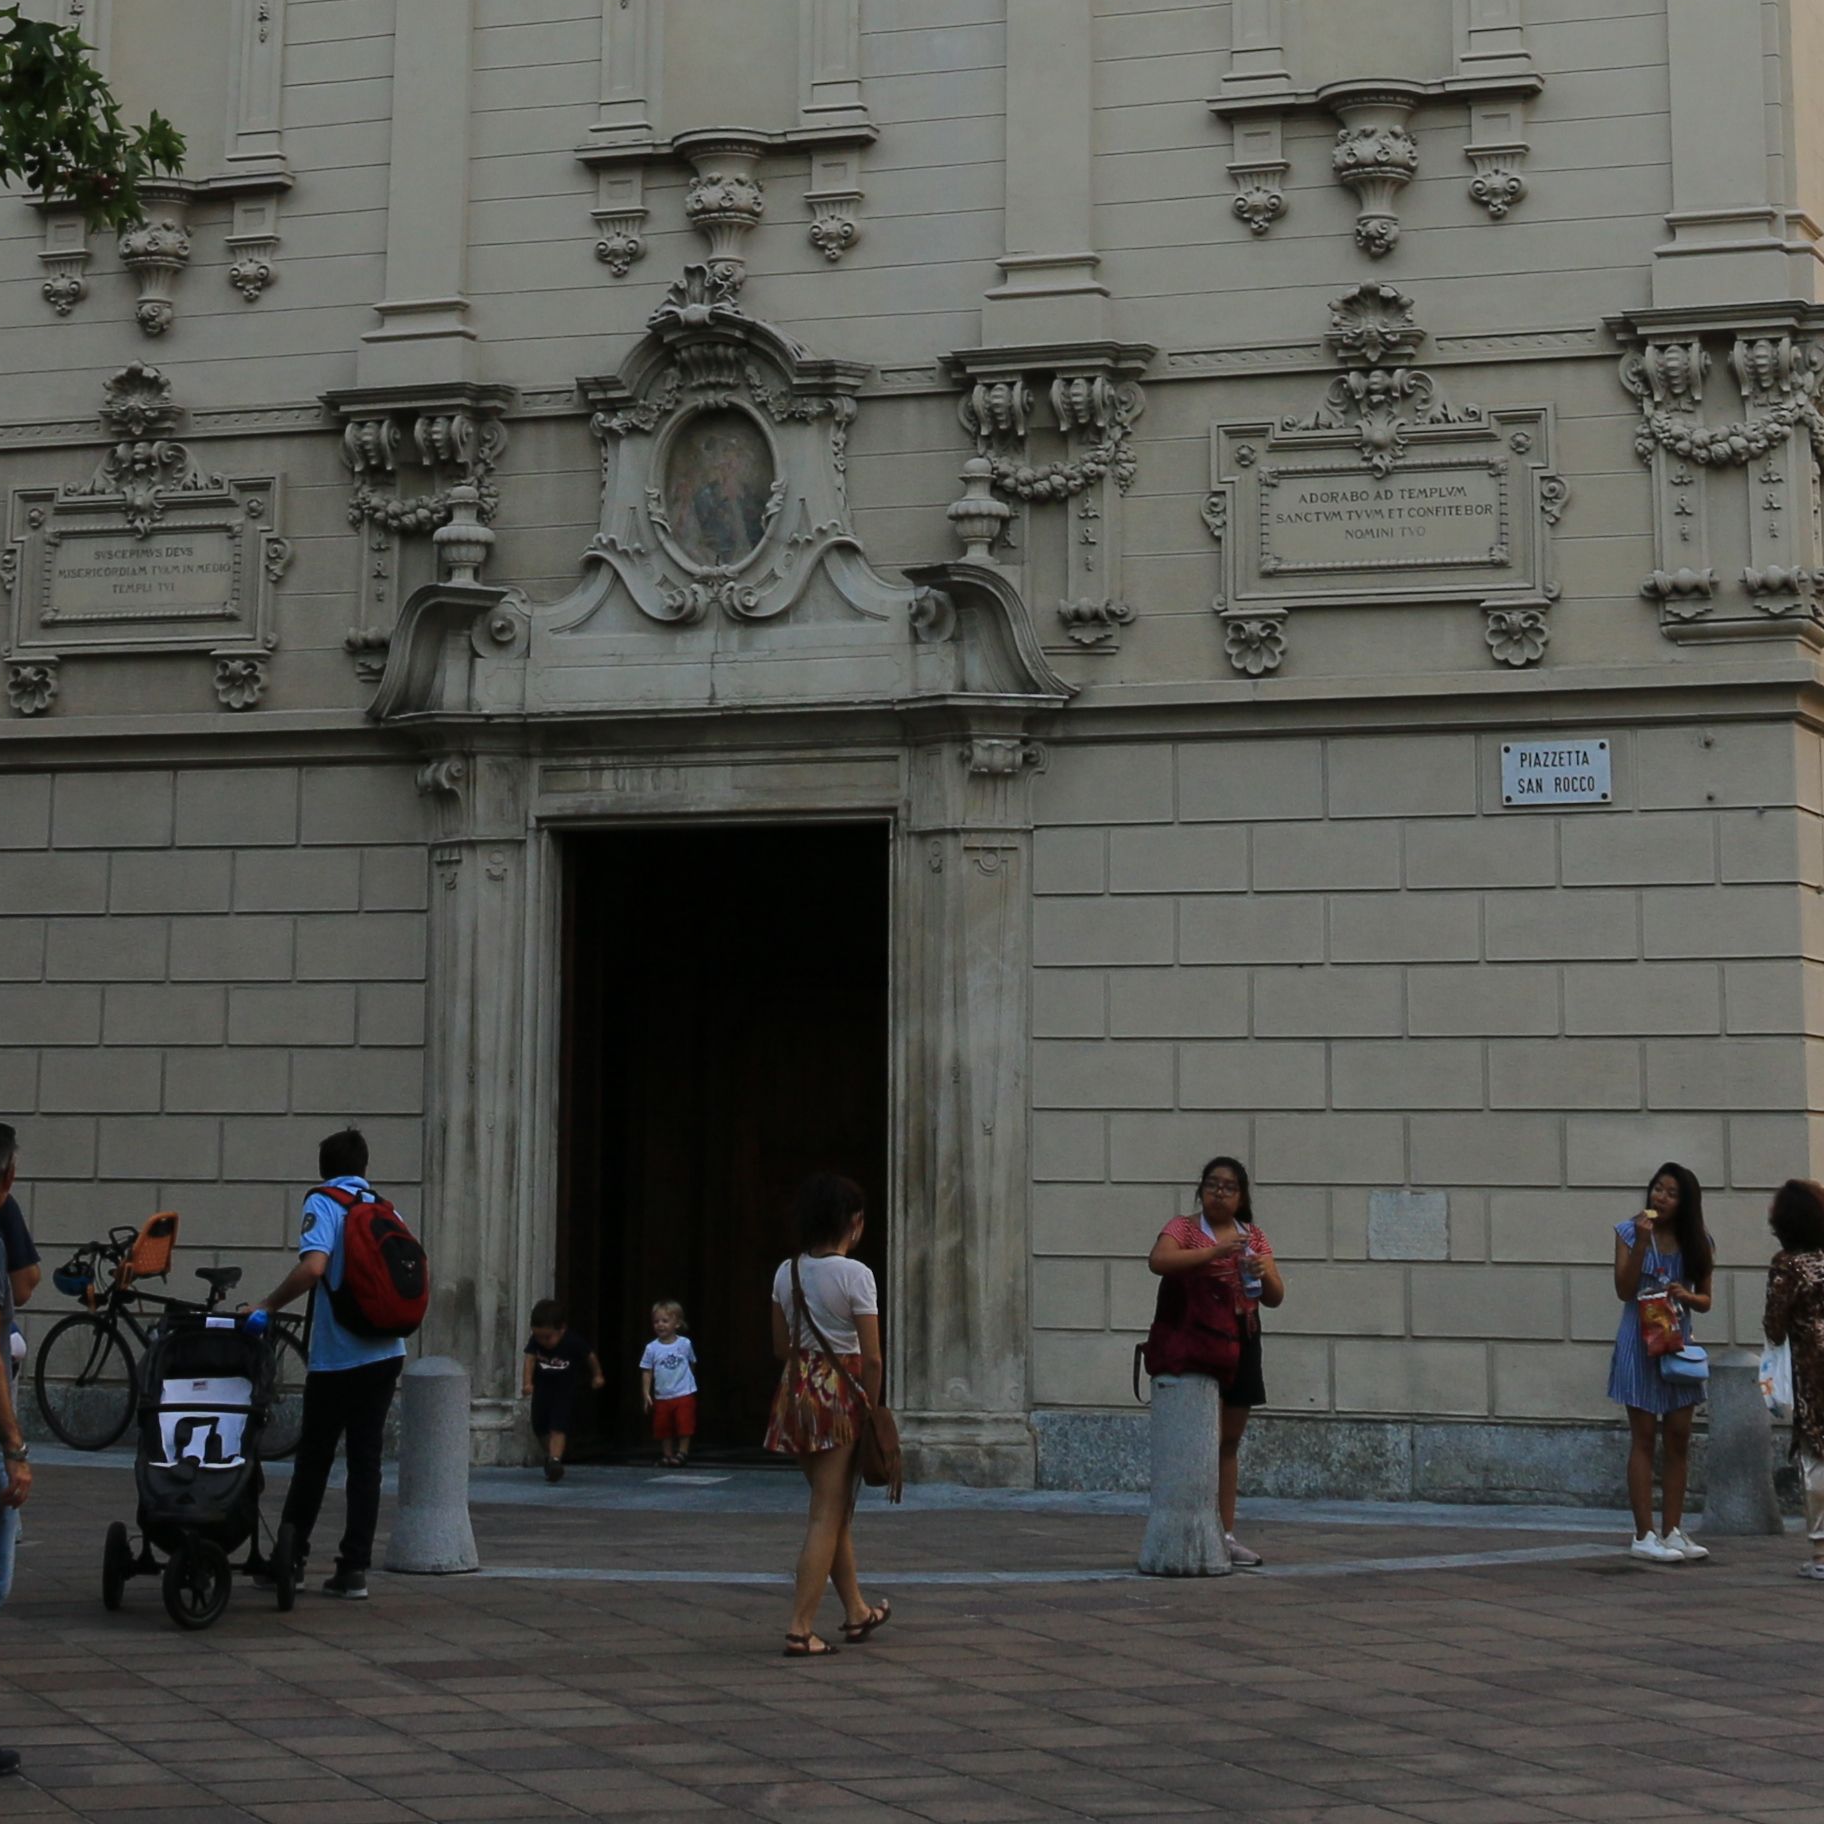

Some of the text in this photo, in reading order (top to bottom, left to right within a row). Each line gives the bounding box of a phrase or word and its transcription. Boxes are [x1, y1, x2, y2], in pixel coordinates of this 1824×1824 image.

[1298, 485, 1467, 504] ADORABO AD TEMPLVM
[1275, 510, 1343, 524] SANCTVM
[1388, 507, 1405, 519] ET
[1407, 503, 1494, 518] CONFITEBOR
[1344, 527, 1395, 540] NOMINI
[165, 546, 194, 558] DEVS
[58, 566, 148, 579] MISERICORDIAM
[197, 563, 231, 574] MEDIO
[1519, 750, 1590, 768] PIAZZETTA
[1517, 776, 1596, 795] SAN ROCCO
